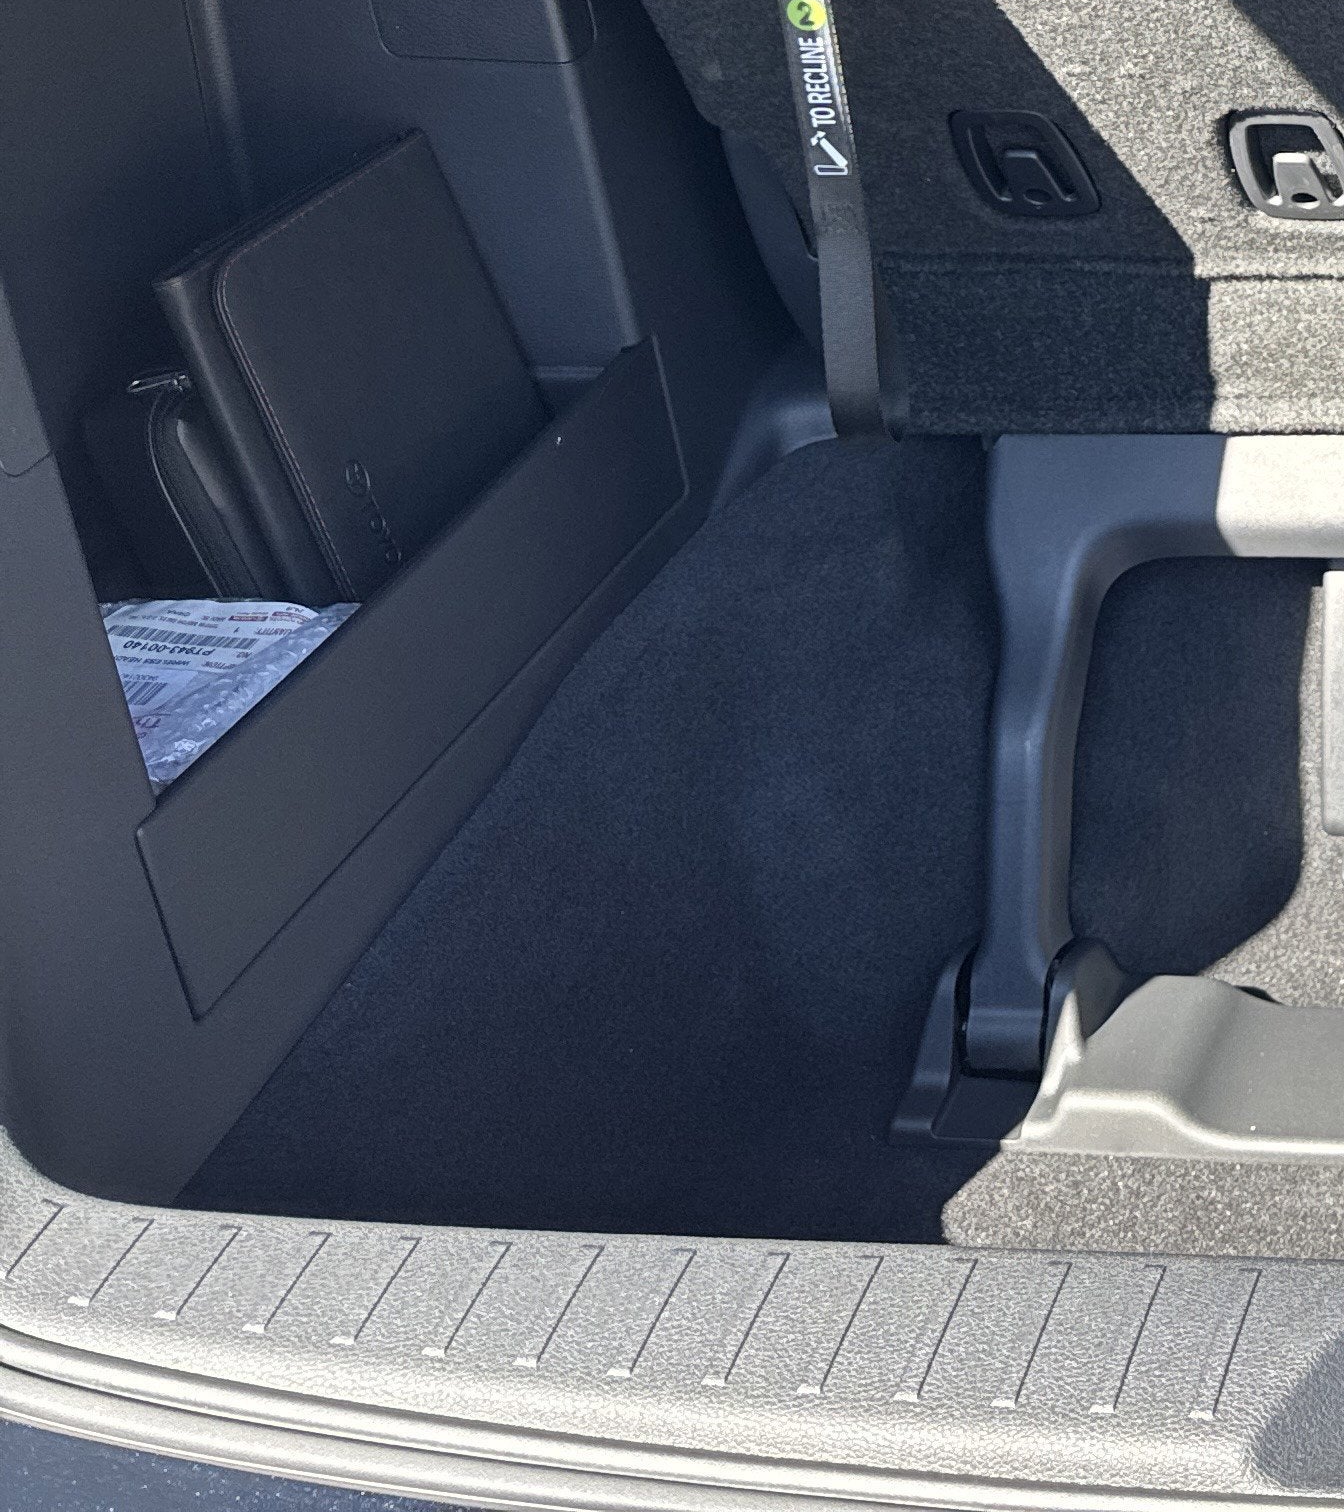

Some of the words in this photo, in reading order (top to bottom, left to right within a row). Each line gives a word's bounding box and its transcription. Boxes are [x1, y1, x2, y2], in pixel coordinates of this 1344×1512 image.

[797, 1, 815, 27] 2
[798, 36, 833, 104] RECLINE
[809, 106, 836, 127] TO
